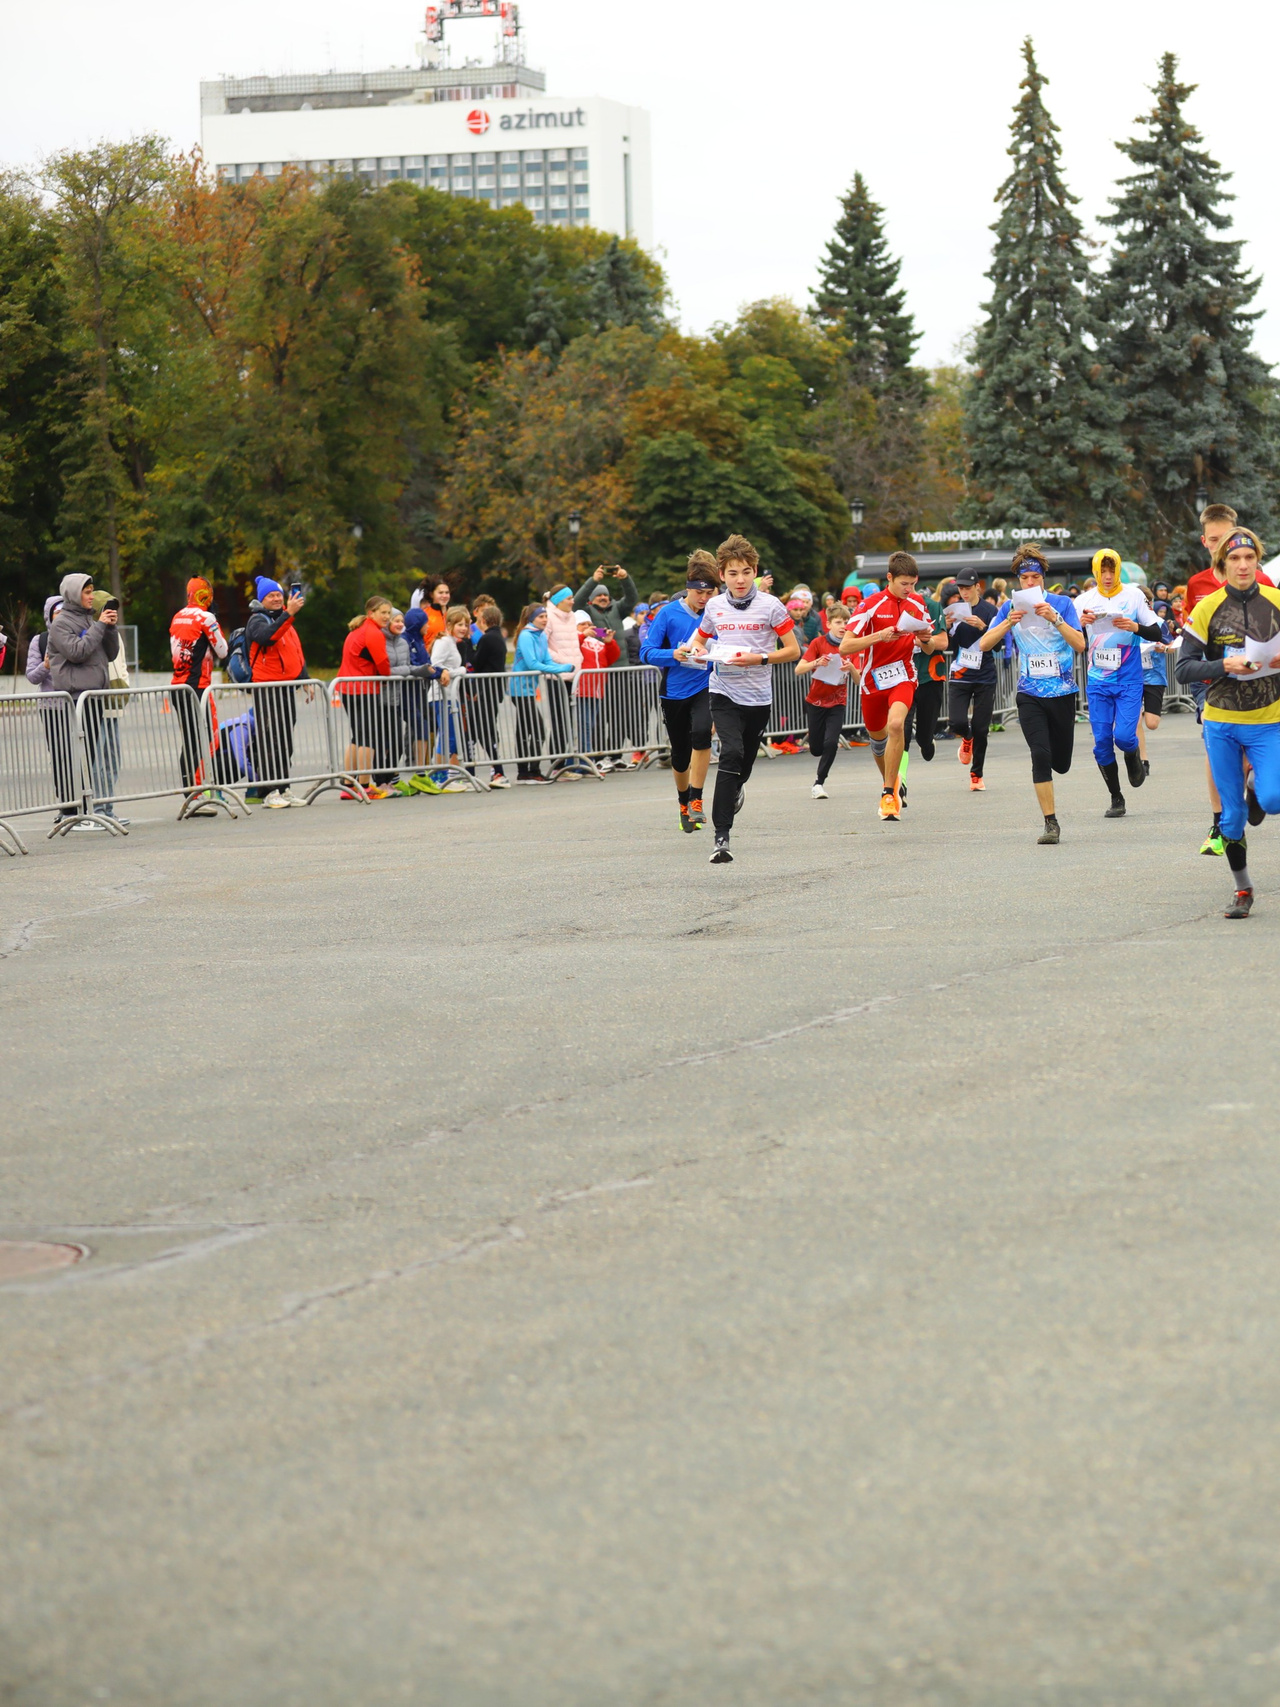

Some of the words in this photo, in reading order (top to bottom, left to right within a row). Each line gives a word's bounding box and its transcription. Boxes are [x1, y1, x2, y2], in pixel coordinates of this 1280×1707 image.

[500, 107, 584, 130] azimut
[911, 529, 1004, 543] УЛЬЯНОВСКАЯ
[1011, 527, 1071, 539] ОБЛАСТЬ
[960, 652, 978, 662] 303.1
[1095, 652, 1116, 661] 304.1
[1029, 659, 1053, 669] 305.1
[878, 667, 901, 682] 322.1
